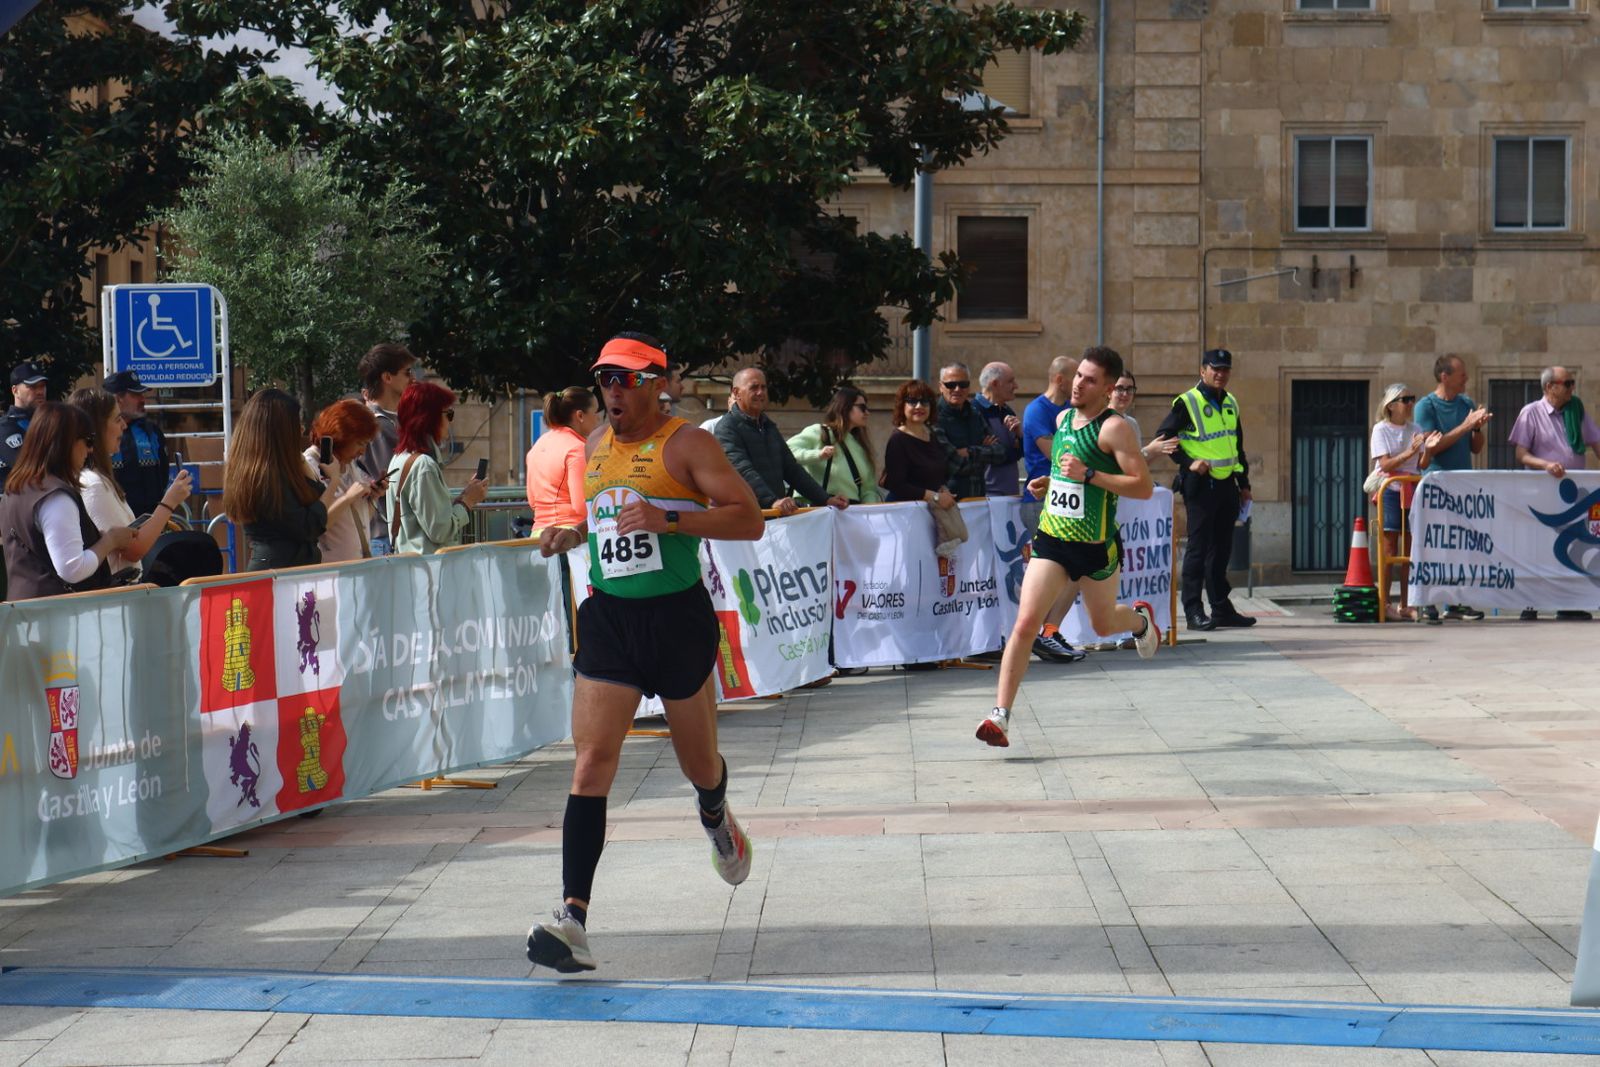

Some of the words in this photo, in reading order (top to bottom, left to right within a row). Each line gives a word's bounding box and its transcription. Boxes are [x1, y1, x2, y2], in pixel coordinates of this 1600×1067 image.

[158, 363, 164, 371] A
[165, 362, 204, 371] PERSONAS
[176, 372, 213, 380] REDUCIDA
[1051, 490, 1080, 510] 240
[601, 533, 654, 564] 485
[753, 561, 828, 607] Plena
[1408, 561, 1466, 586] CASTILLA
[1469, 563, 1478, 587] Y
[1479, 562, 1515, 589] LEÓN
[965, 600, 973, 617] y
[393, 631, 423, 667] DE
[475, 668, 487, 701] Y
[490, 656, 538, 699] LEÓN
[84, 737, 136, 772] Junta
[140, 729, 162, 760] de
[38, 783, 100, 822] Castilla
[103, 785, 114, 820] y
[118, 771, 162, 806] León
